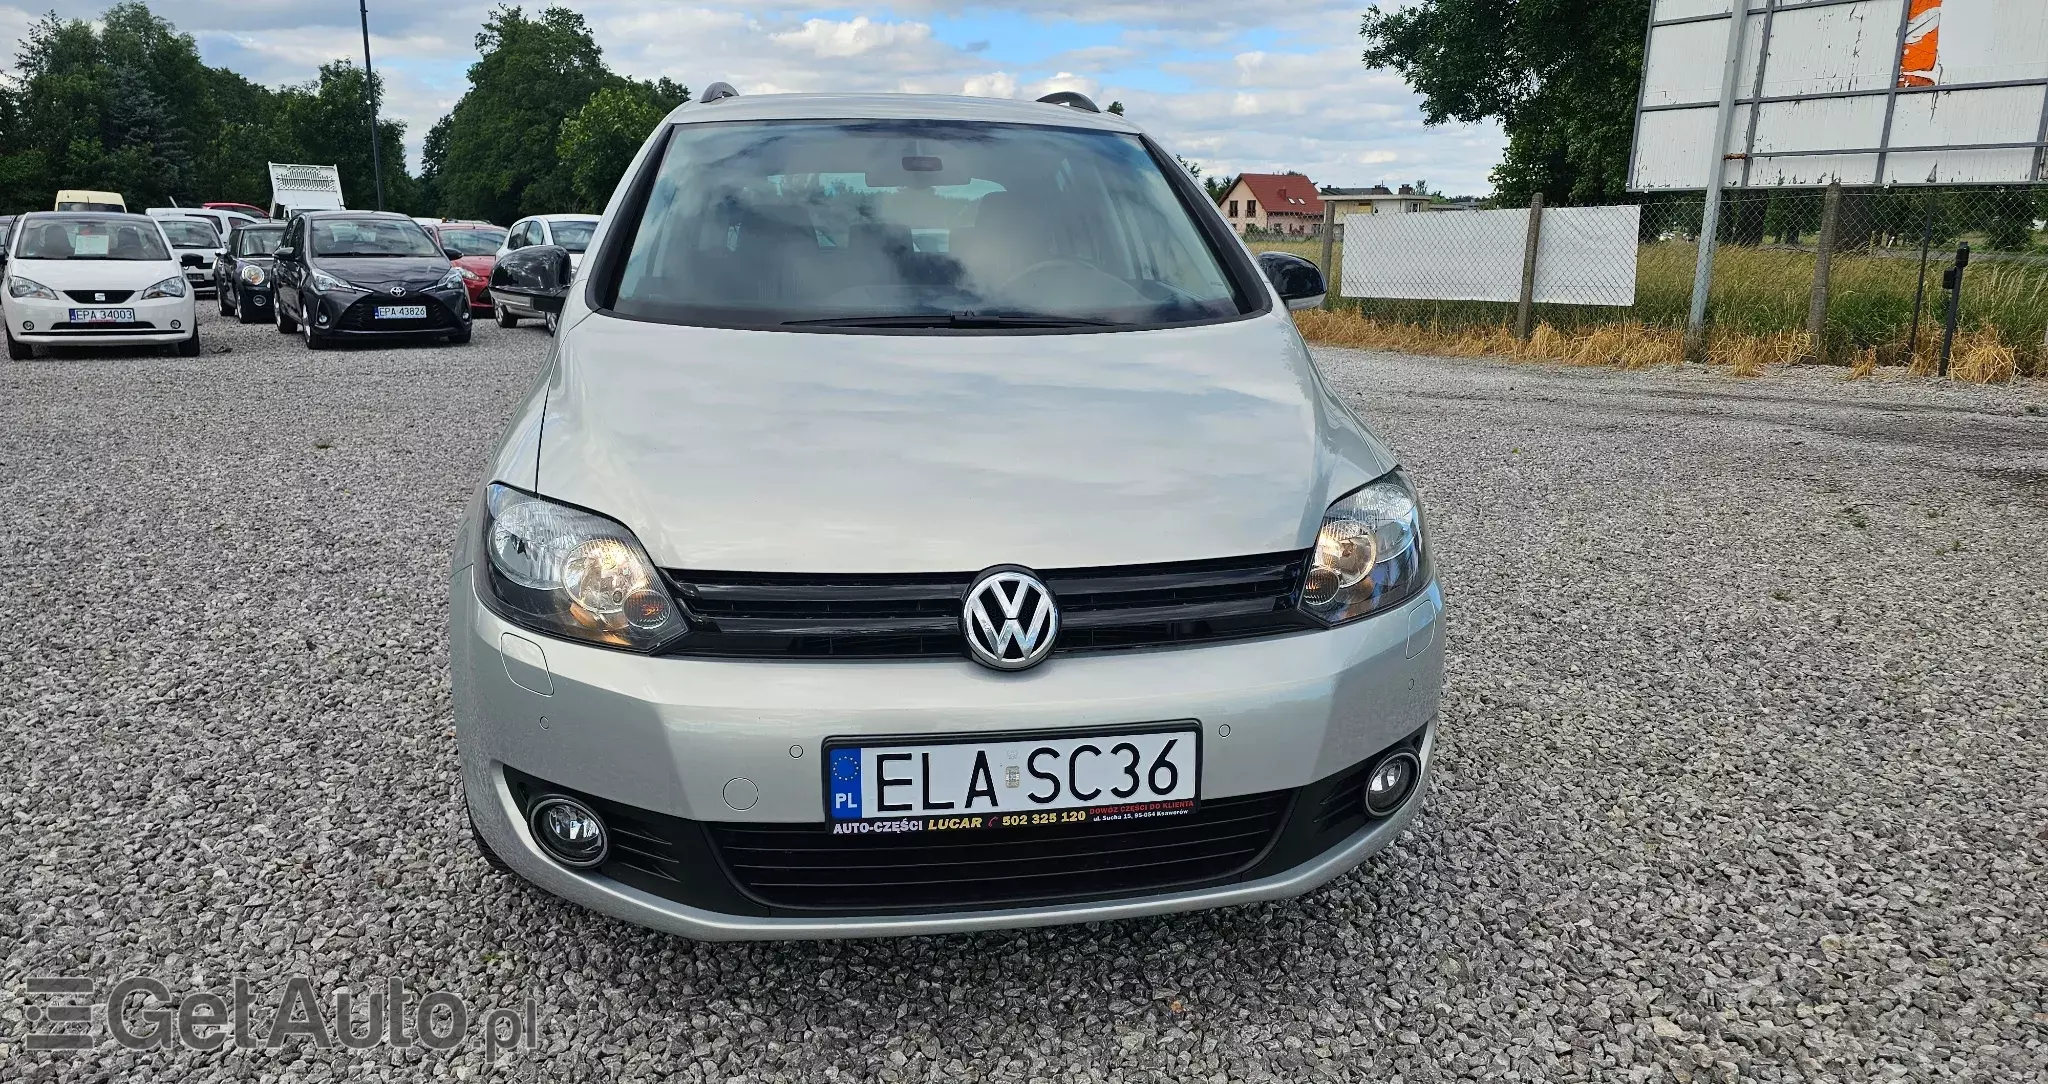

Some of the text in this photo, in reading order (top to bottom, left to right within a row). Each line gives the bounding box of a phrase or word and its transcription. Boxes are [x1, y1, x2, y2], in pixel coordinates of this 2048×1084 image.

[76, 310, 97, 320] EPA
[100, 310, 133, 320] 34003
[380, 307, 425, 316] EPA 43826
[876, 739, 1179, 812] ELA SC36
[835, 793, 858, 809] PL
[1162, 800, 1194, 809] KLIENTA
[832, 810, 1087, 835] AUTO-CZĘŚCI LUCAR 502 325 120
